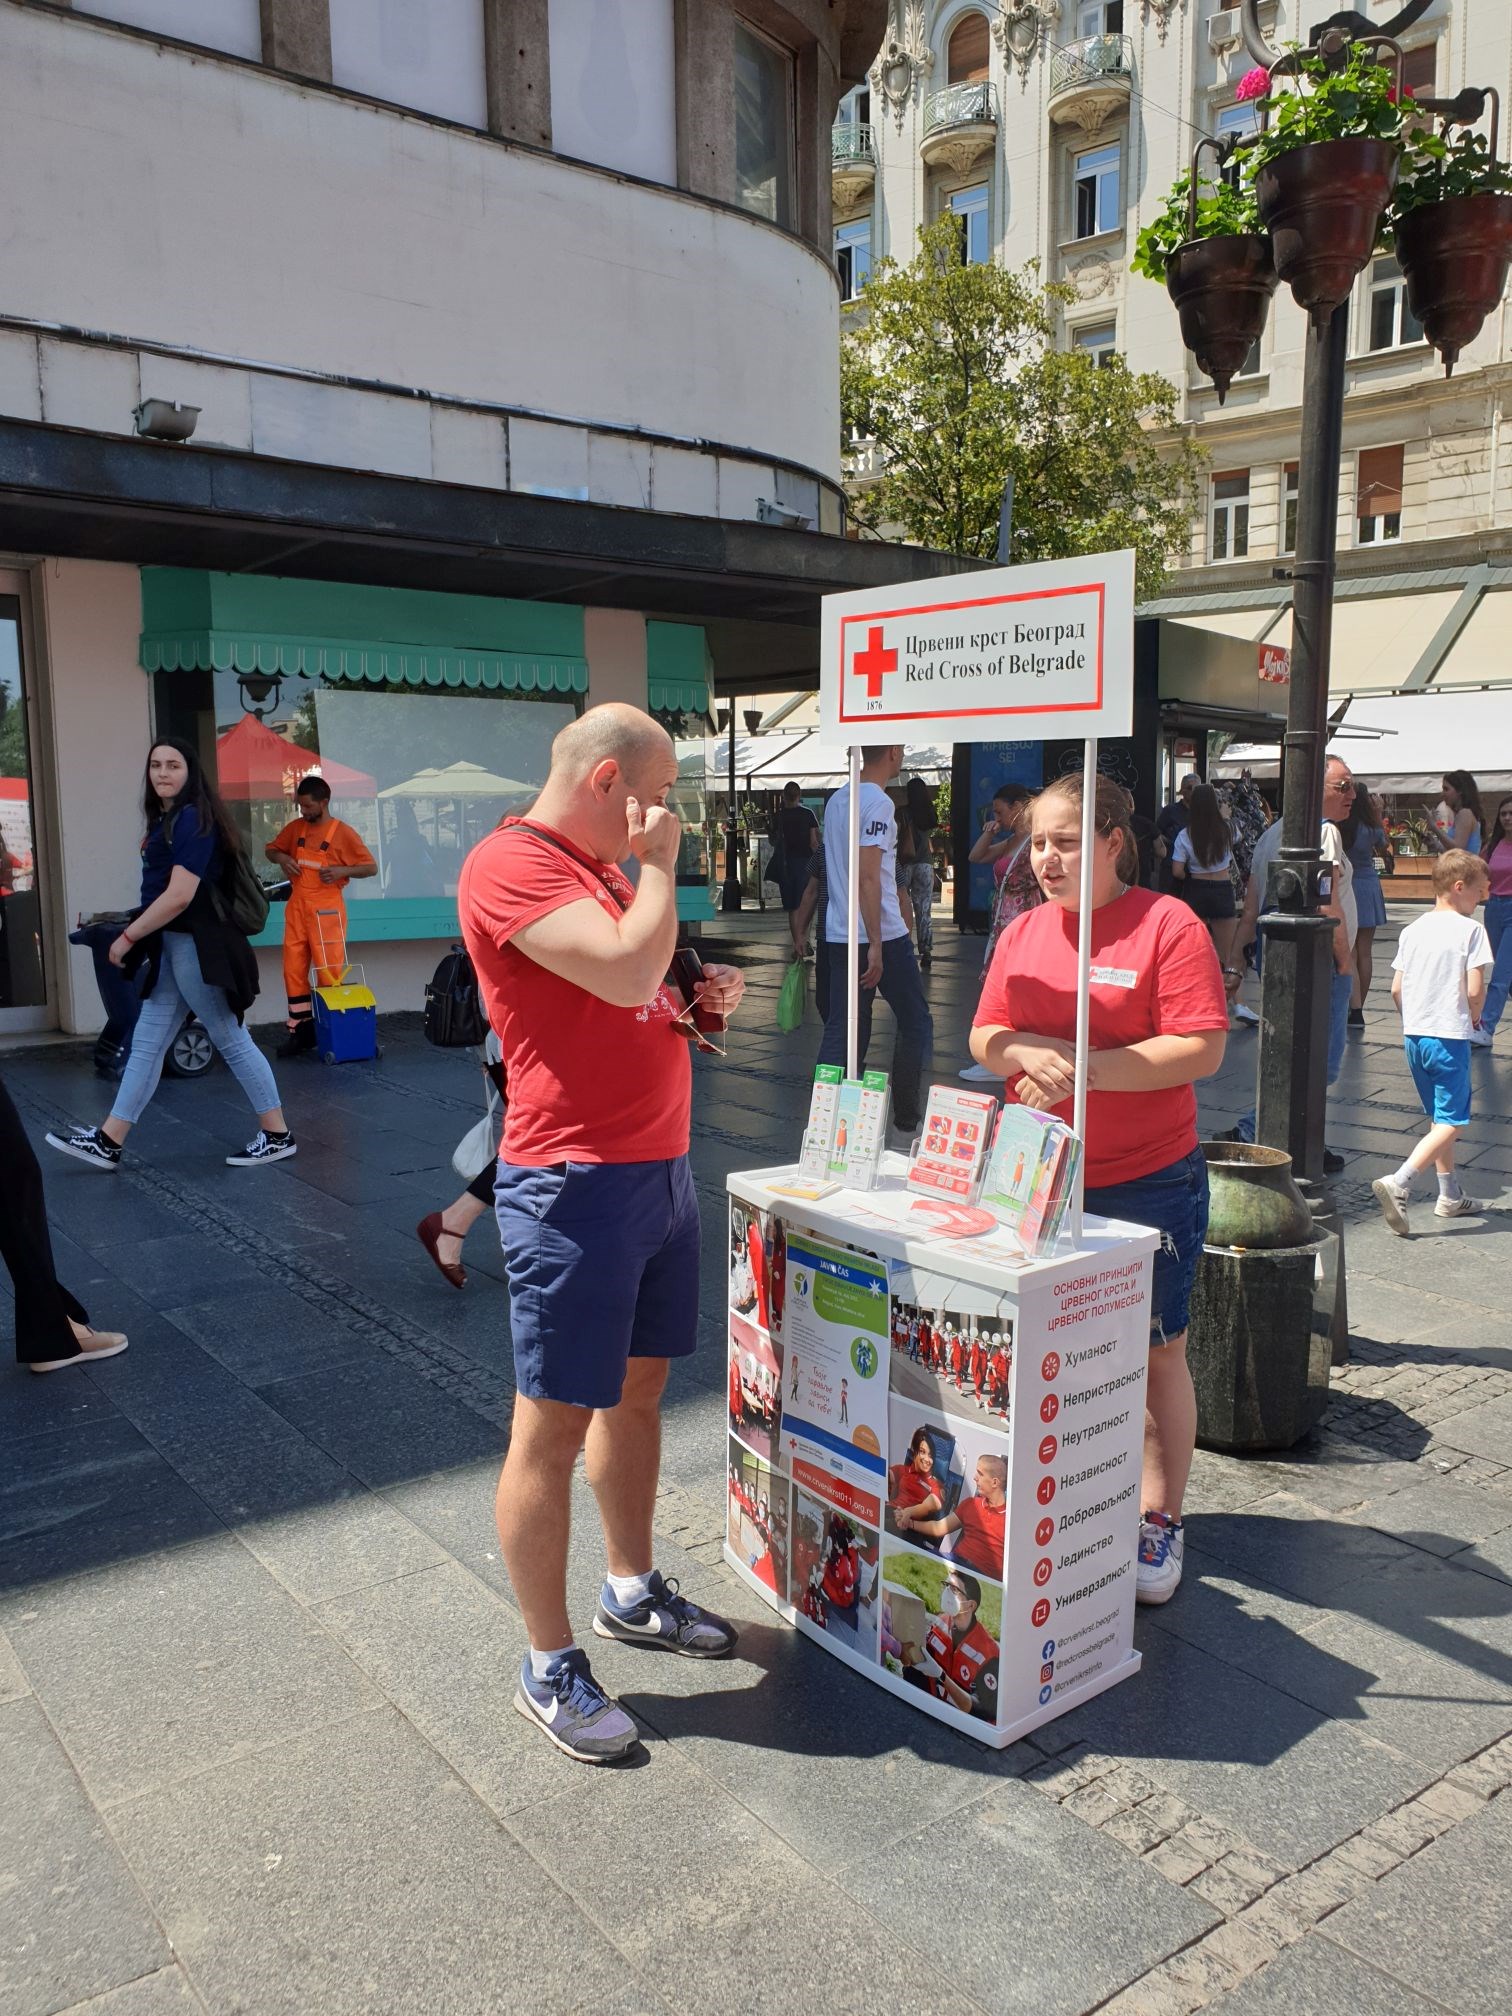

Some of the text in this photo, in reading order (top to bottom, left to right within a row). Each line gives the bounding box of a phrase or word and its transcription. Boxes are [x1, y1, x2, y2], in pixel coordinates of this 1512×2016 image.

[905, 622, 1086, 658] Црвени крст Београд
[905, 649, 1086, 683] Red Cross of Belgrade
[866, 700, 883, 712] 1876
[837, 1265, 849, 1278] ČAS
[1053, 1260, 1143, 1296] ОСНОВНИ ПРИНЦИПИ
[1047, 1291, 1145, 1332] ЦРВЕНОГ ПОЛУМЕСЕЦА
[1060, 1278, 1136, 1311] ЦРВЕНОГ КРСТА И
[1064, 1339, 1118, 1368] Хуманост
[1063, 1365, 1146, 1409] Непристрасност
[1061, 1410, 1130, 1448] Неутралност
[1060, 1450, 1128, 1490] Независност
[1058, 1483, 1137, 1534] Добровољност
[1056, 1534, 1114, 1570] Јединство
[1055, 1560, 1132, 1611] Универзалност
[1057, 1608, 1120, 1649] @crvenikrst.beograd
[1056, 1632, 1116, 1670] @redcrossbelgrade
[1054, 1661, 1103, 1693] @crvenikrstinfo
